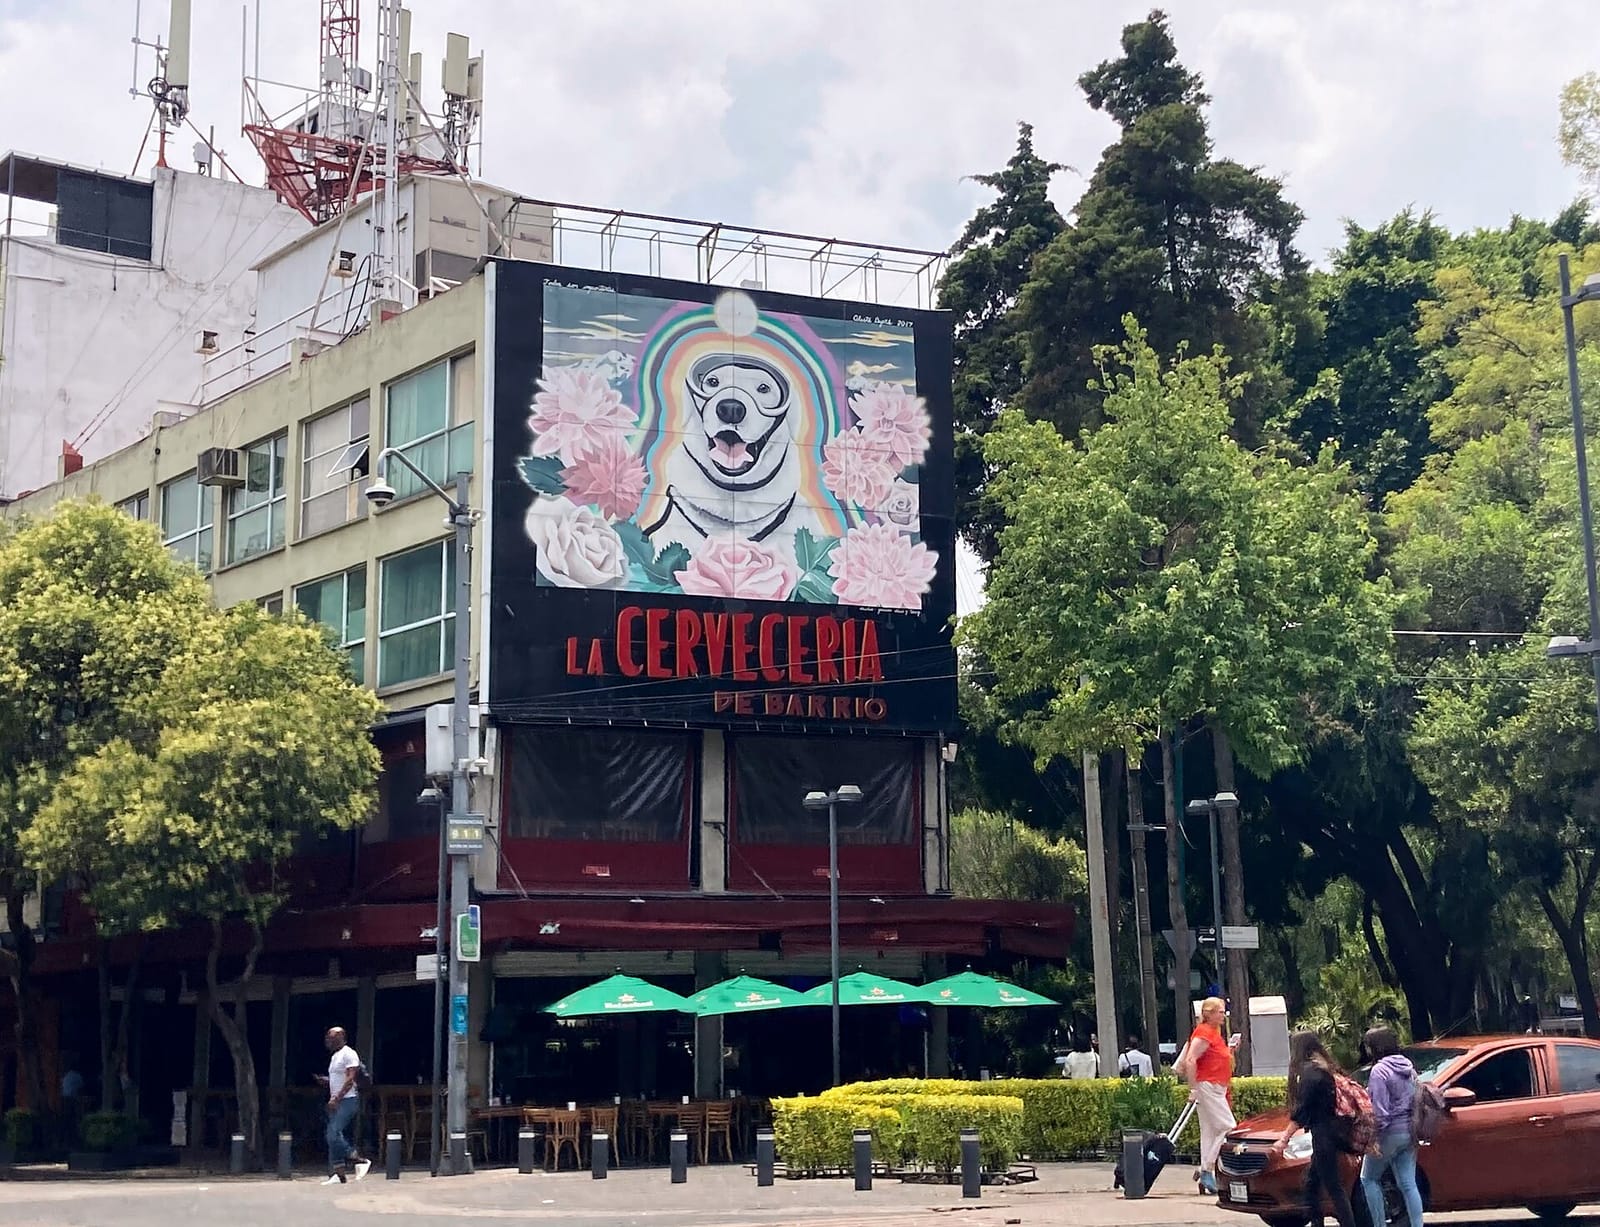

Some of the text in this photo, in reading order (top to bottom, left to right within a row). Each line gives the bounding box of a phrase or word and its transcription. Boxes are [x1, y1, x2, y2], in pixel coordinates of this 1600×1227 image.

[566, 606, 884, 684] LA CERVECERIA
[714, 691, 887, 720] DE BARRIO
